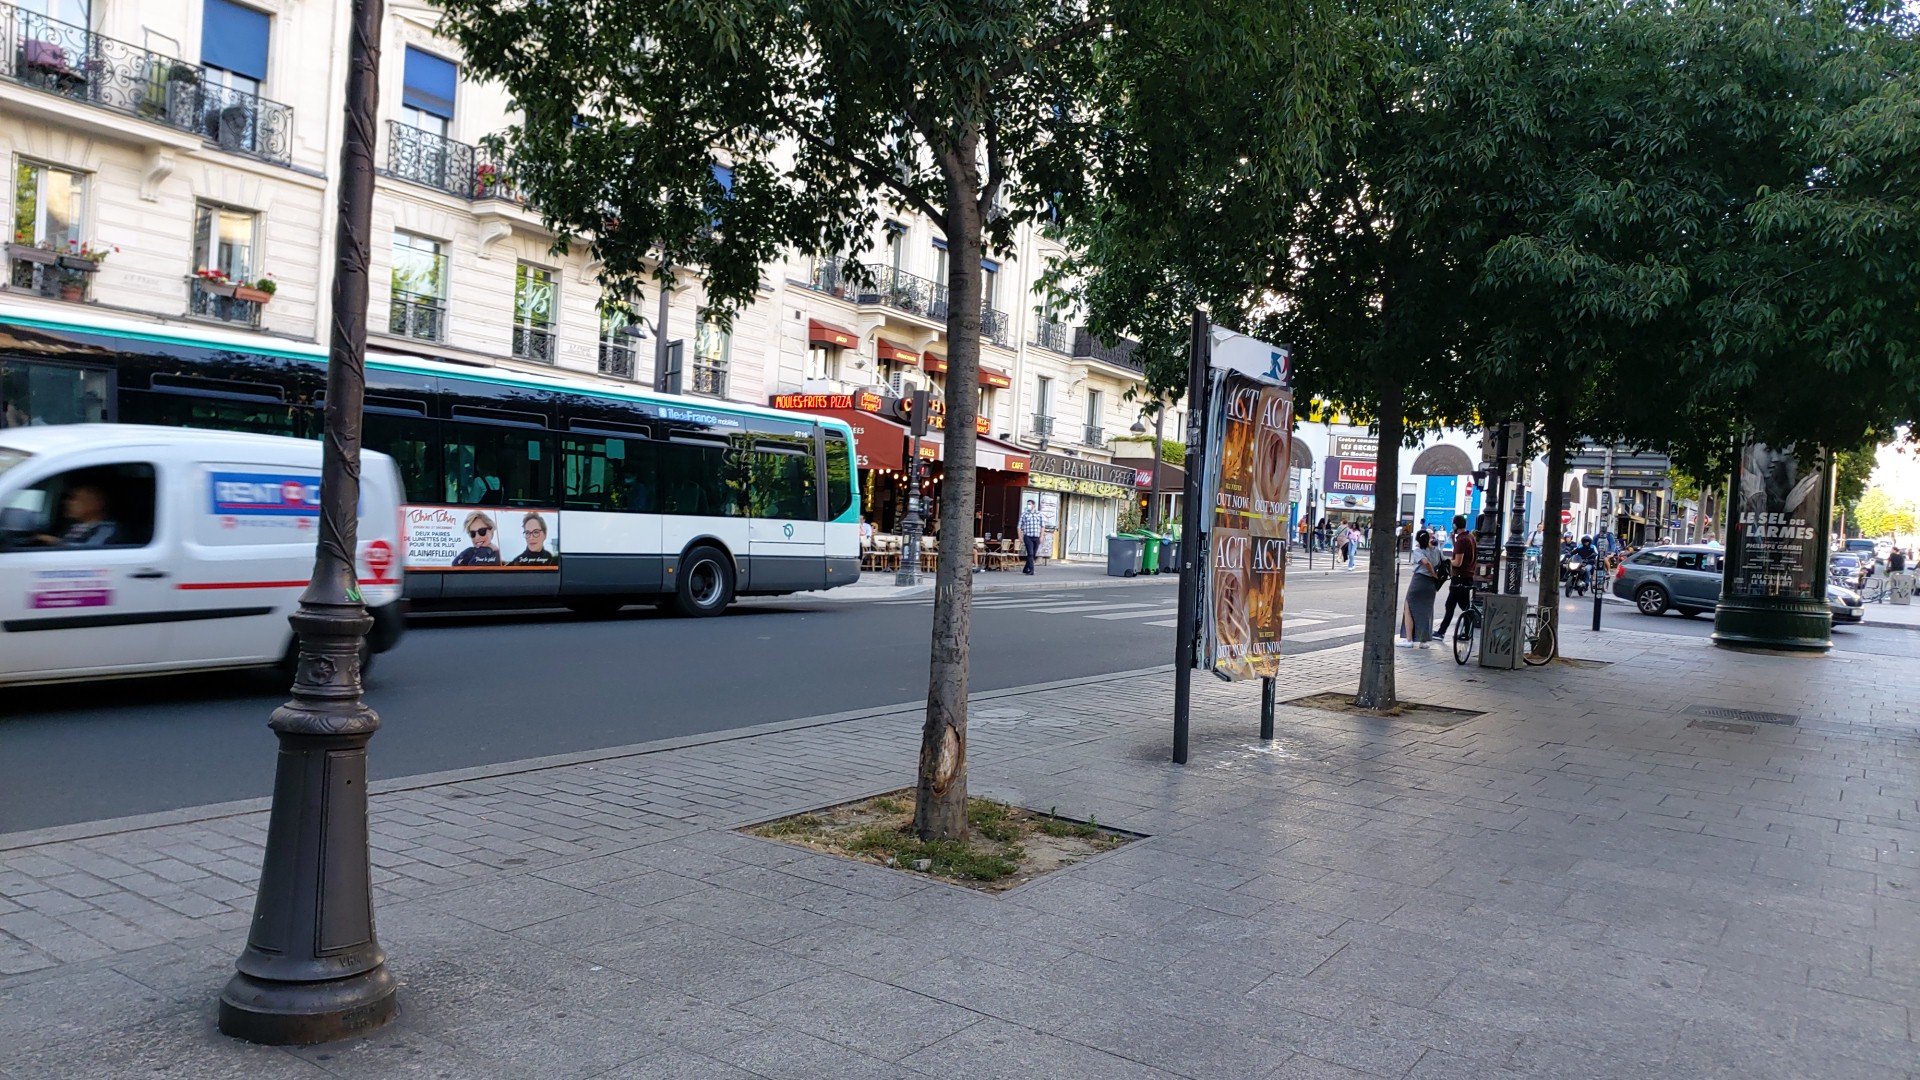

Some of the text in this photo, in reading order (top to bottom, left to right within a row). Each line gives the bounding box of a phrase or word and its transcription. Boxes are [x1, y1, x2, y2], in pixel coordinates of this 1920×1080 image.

[830, 395, 852, 408] PIZZA
[1227, 384, 1260, 421] ACT
[1260, 396, 1293, 432] ACT
[1063, 460, 1105, 481] PANINI
[1136, 471, 1152, 486] illy
[1333, 481, 1373, 491] RESTAURANT
[1216, 492, 1232, 507] OUT
[1254, 499, 1270, 513] OUT
[1270, 501, 1287, 515] NOW
[1739, 511, 1806, 526] LE SEL DES
[1745, 525, 1815, 540] LARMES
[1215, 535, 1248, 569] ACT
[1252, 538, 1286, 570] ACT
[1252, 642, 1266, 655] OUT
